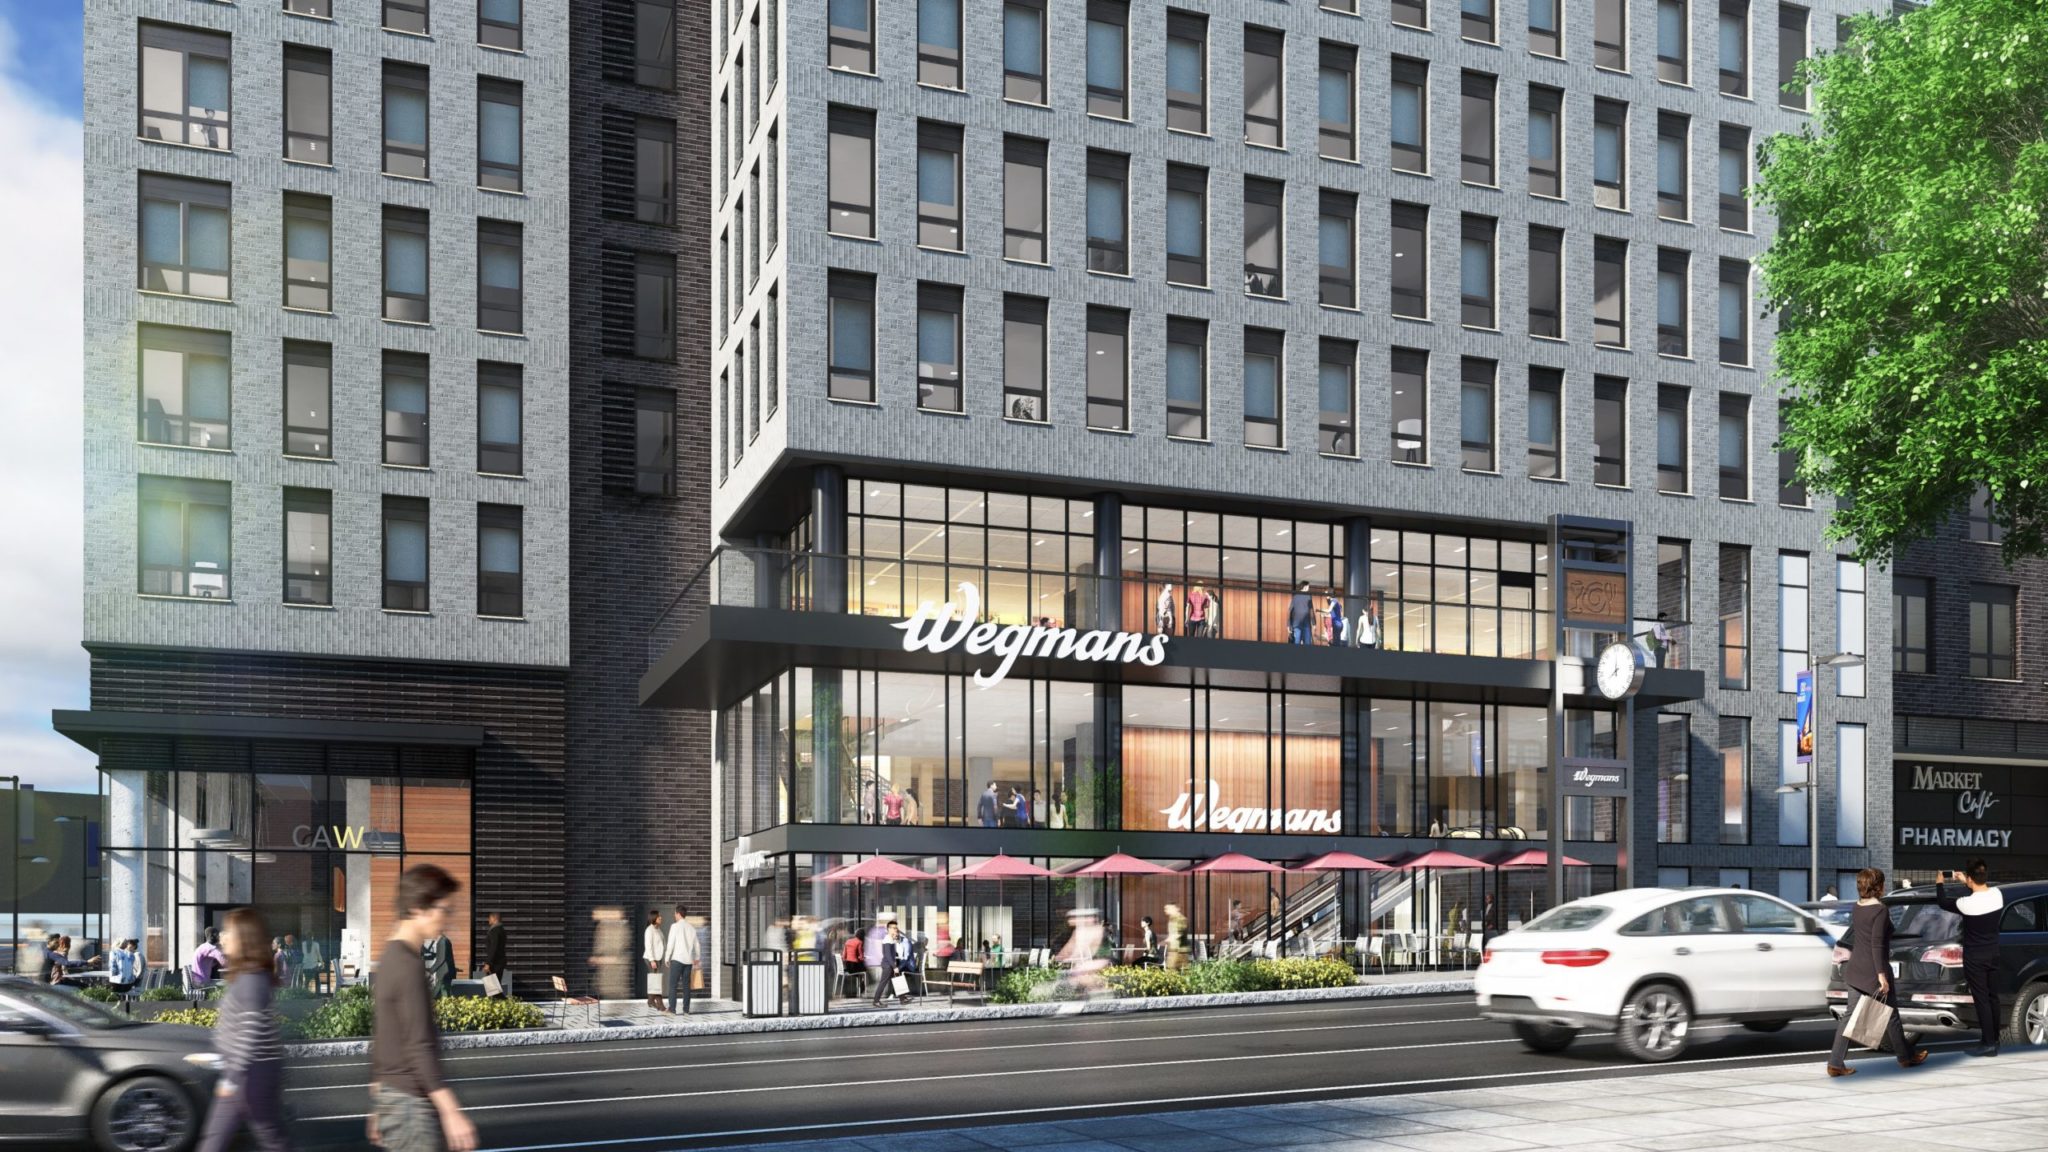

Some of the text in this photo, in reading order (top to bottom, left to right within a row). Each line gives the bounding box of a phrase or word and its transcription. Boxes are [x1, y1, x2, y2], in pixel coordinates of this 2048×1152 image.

[891, 581, 1169, 688] Wegmans
[1573, 767, 1620, 787] Wegmans
[1902, 828, 2012, 847] PHARMACY
